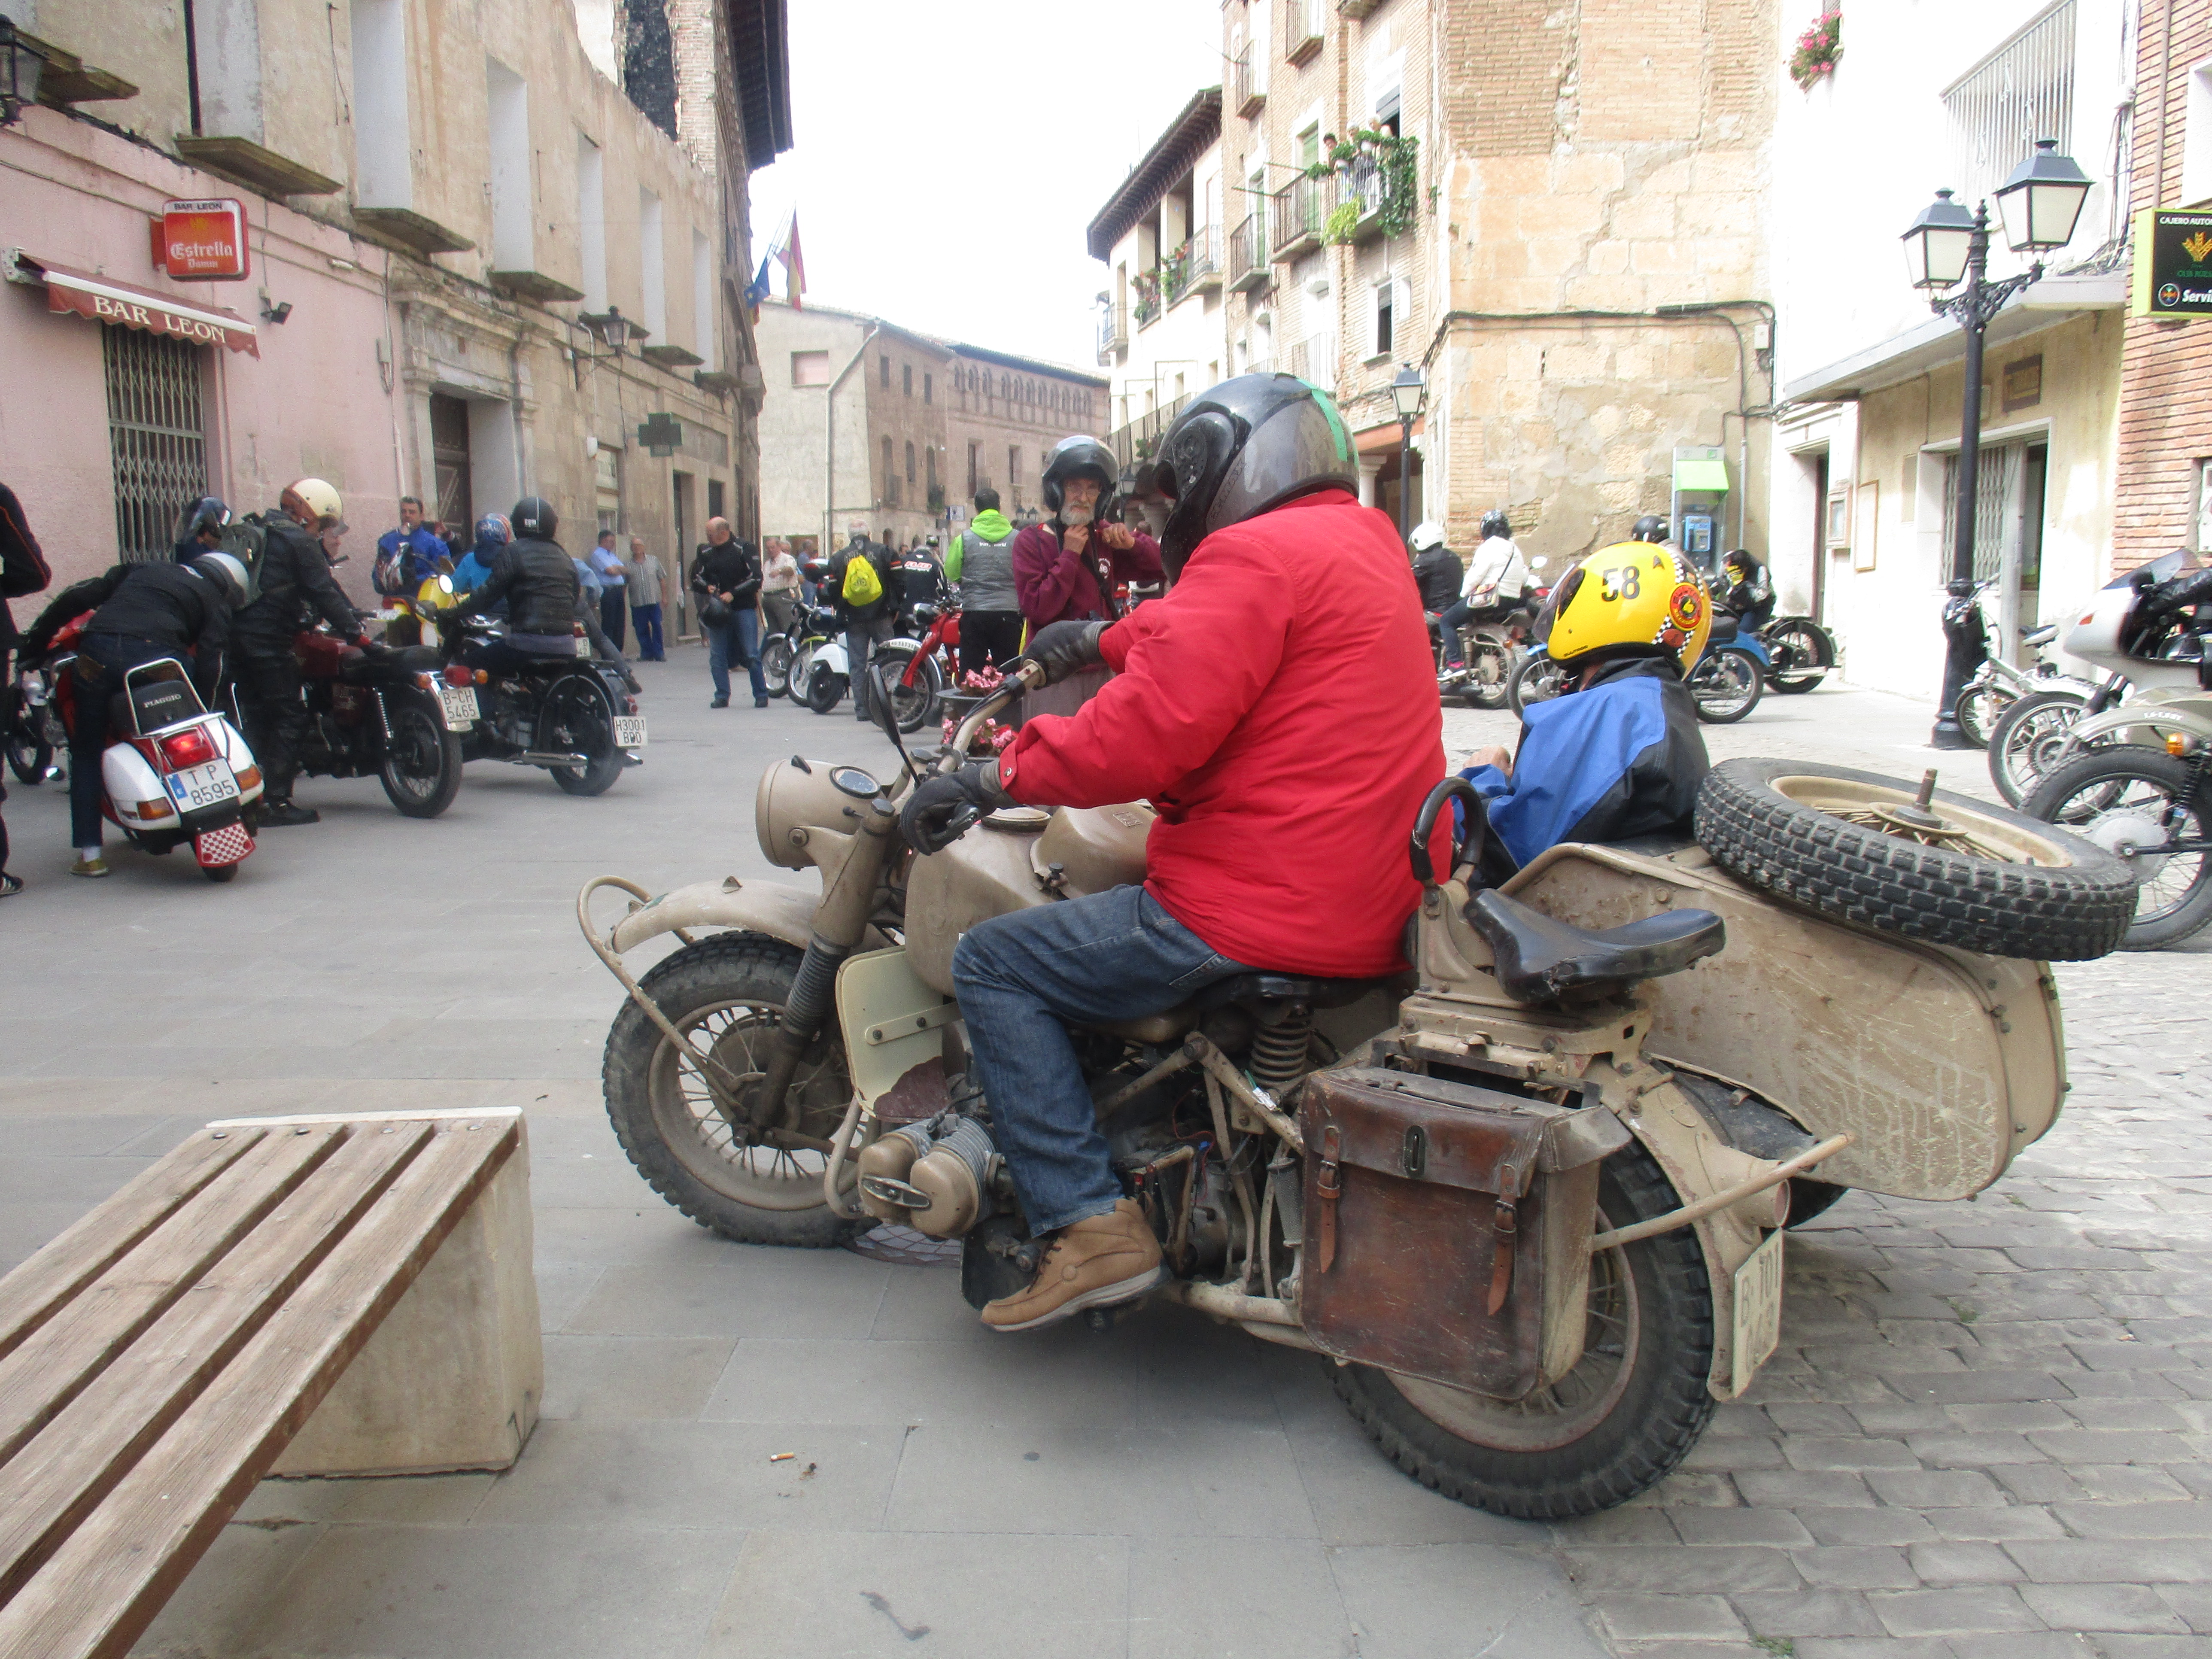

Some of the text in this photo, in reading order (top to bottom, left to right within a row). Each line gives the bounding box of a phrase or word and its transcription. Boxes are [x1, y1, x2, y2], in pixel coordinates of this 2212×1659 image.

[2189, 217, 2212, 225] AUTO
[170, 241, 233, 259] Estrella
[2182, 289, 2212, 302] Servi
[93, 296, 226, 343] BAR LEON
[1601, 565, 1640, 602] 58
[143, 694, 181, 708] PIAGGIO
[443, 690, 473, 705] B-CH
[447, 704, 475, 718] 5465
[615, 719, 644, 731] H3001
[187, 765, 216, 785] T P
[191, 780, 234, 805] 8595
